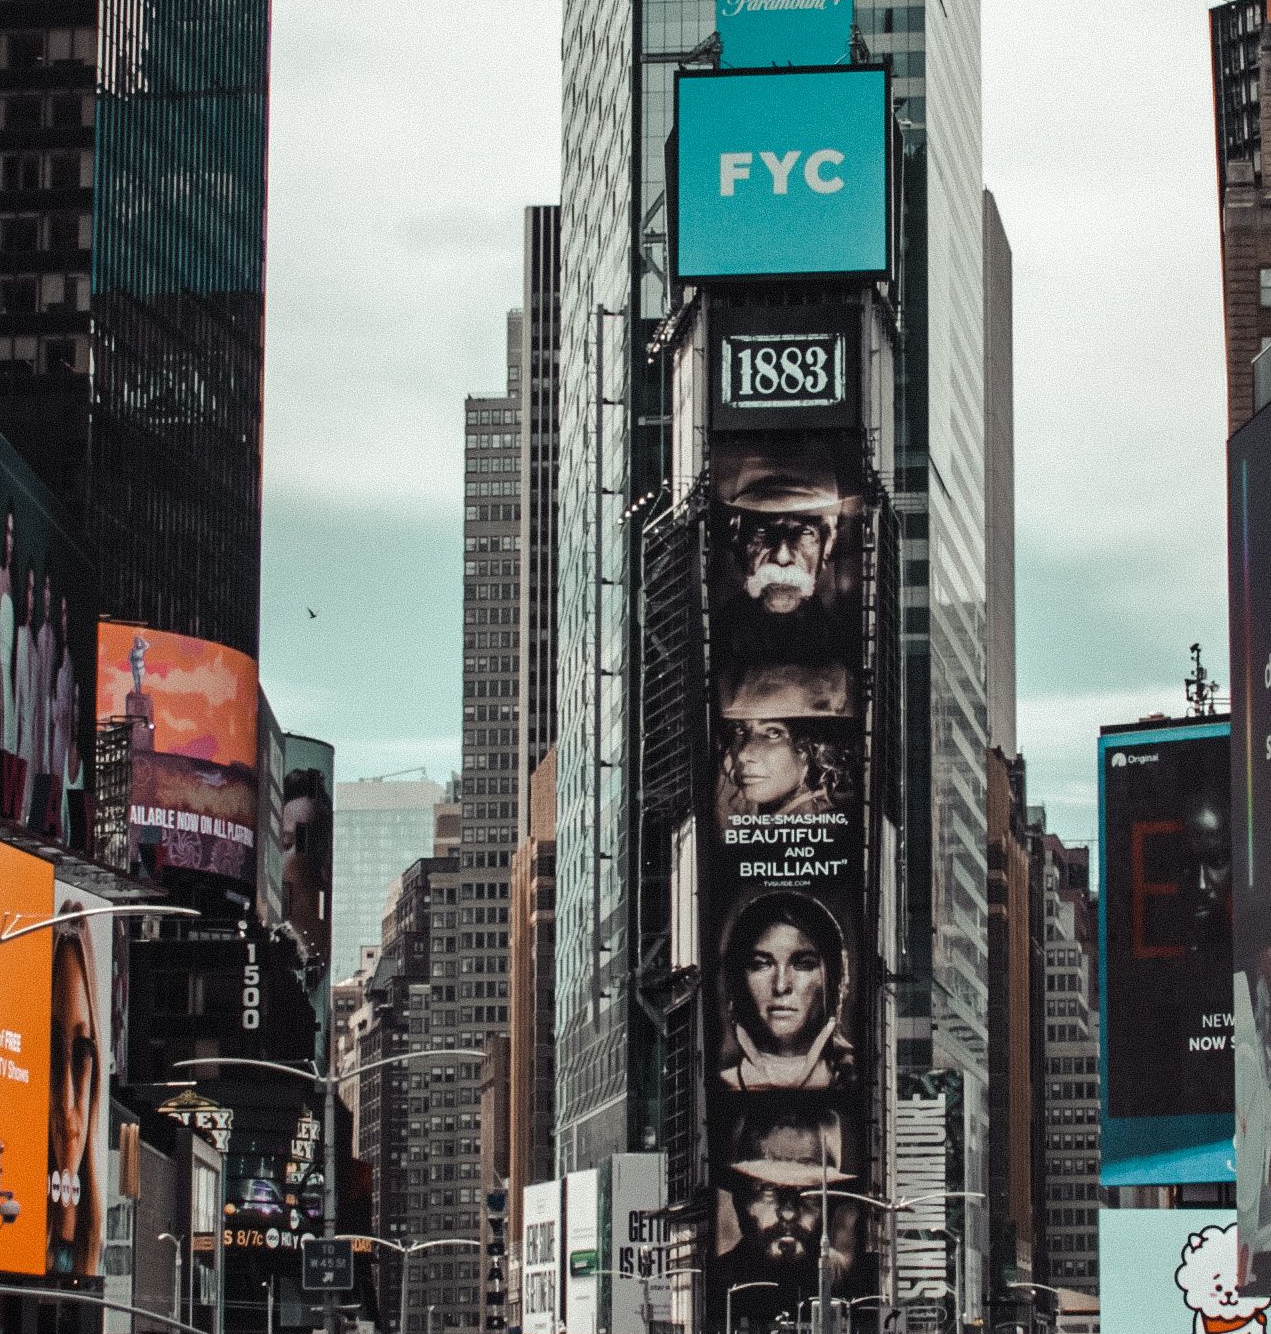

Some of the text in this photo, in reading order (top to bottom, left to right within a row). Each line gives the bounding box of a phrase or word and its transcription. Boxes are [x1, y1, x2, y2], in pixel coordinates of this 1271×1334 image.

[719, 148, 846, 197] FYC
[737, 345, 826, 395] 1883
[1128, 753, 1159, 765] Original
[725, 828, 834, 844] BEAUTIFUL
[784, 847, 815, 857] AND
[243, 943, 261, 1032] 1500
[1202, 1013, 1235, 1028] NEW
[1189, 1035, 1226, 1052] NOW
[896, 1093, 948, 1299] STAY IMMATURE
